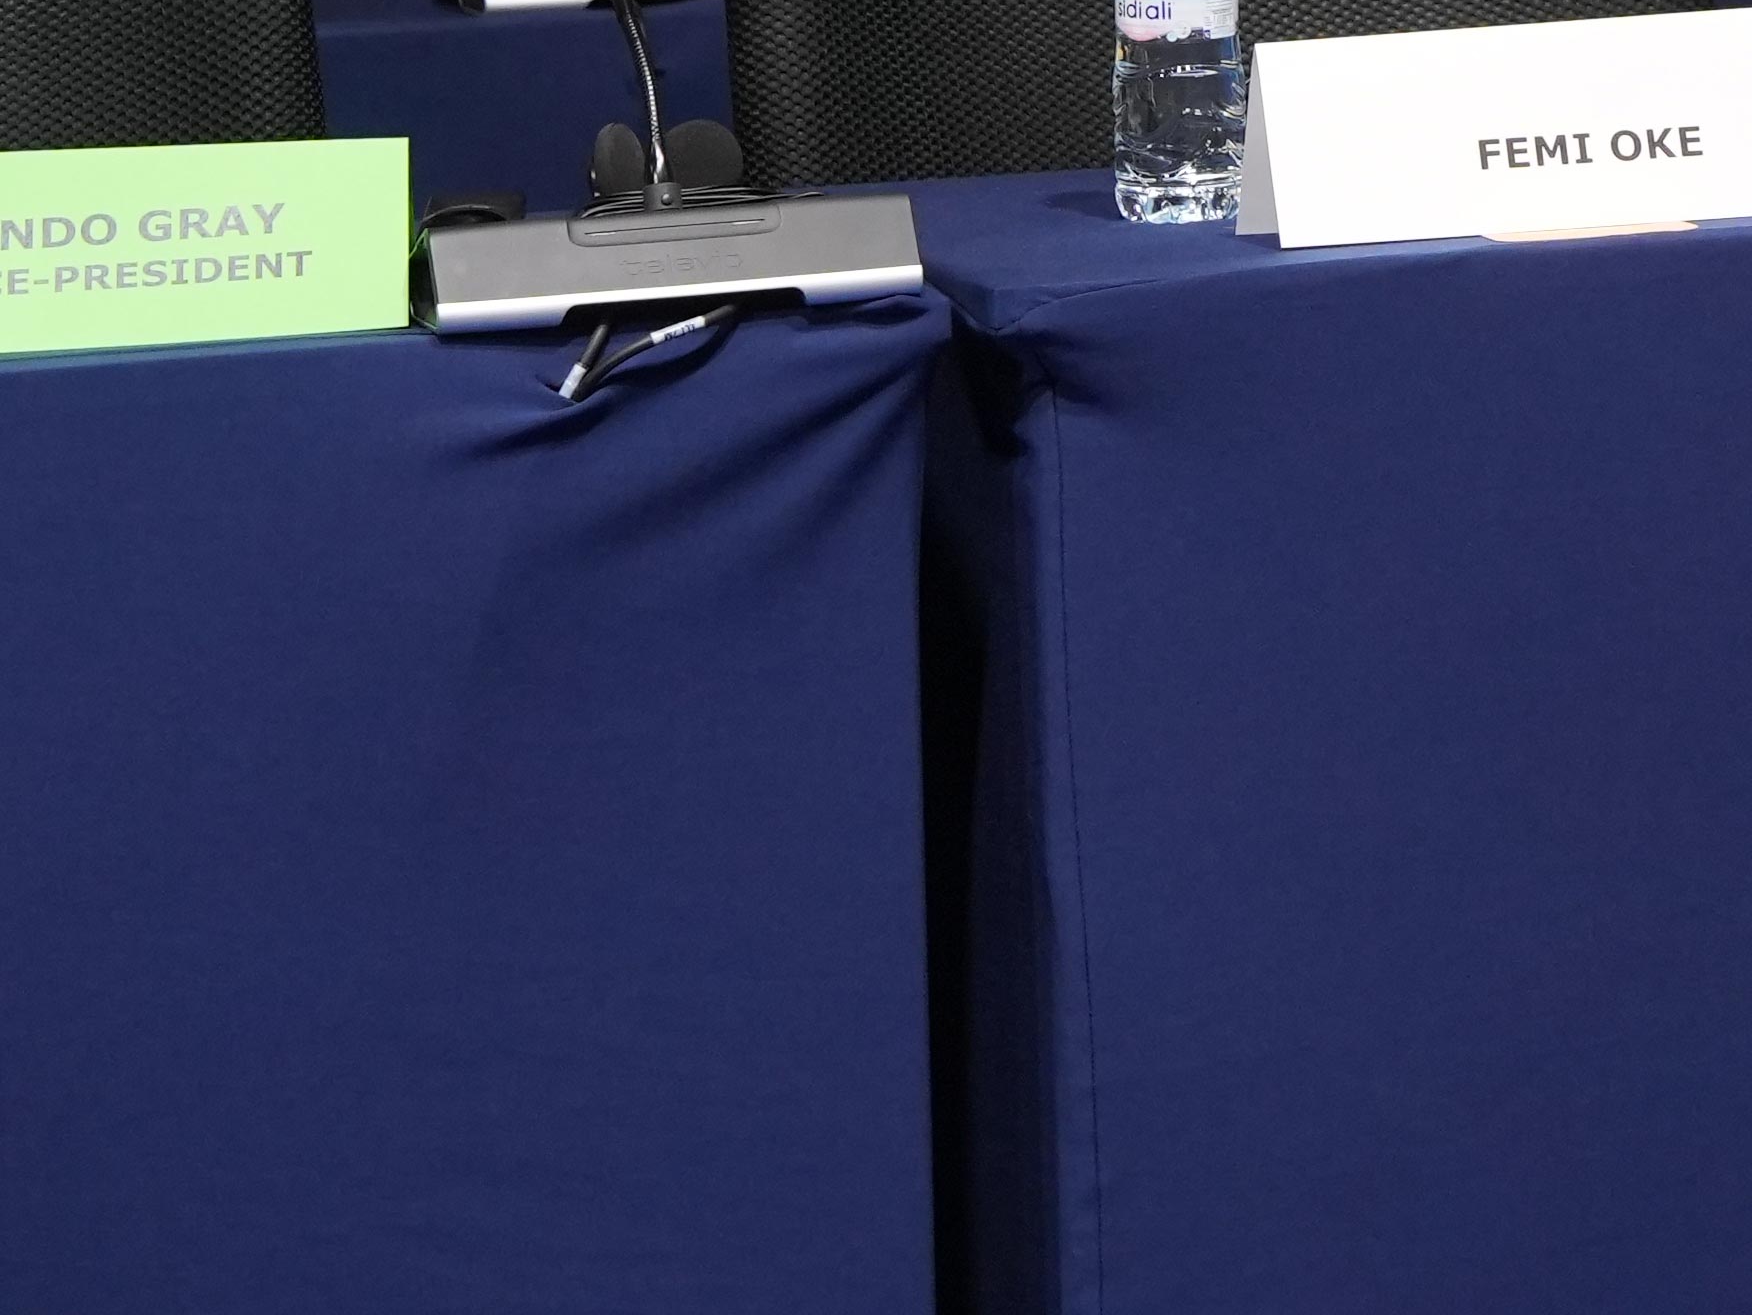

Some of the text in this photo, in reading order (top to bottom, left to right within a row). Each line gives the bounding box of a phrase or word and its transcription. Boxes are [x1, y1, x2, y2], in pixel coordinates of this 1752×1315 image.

[1118, 0, 1172, 20] sidi ali
[1478, 126, 1704, 170] FEMI OKE
[0, 202, 286, 251] NDO GRAY
[0, 250, 313, 296] E-PRESIDENT
